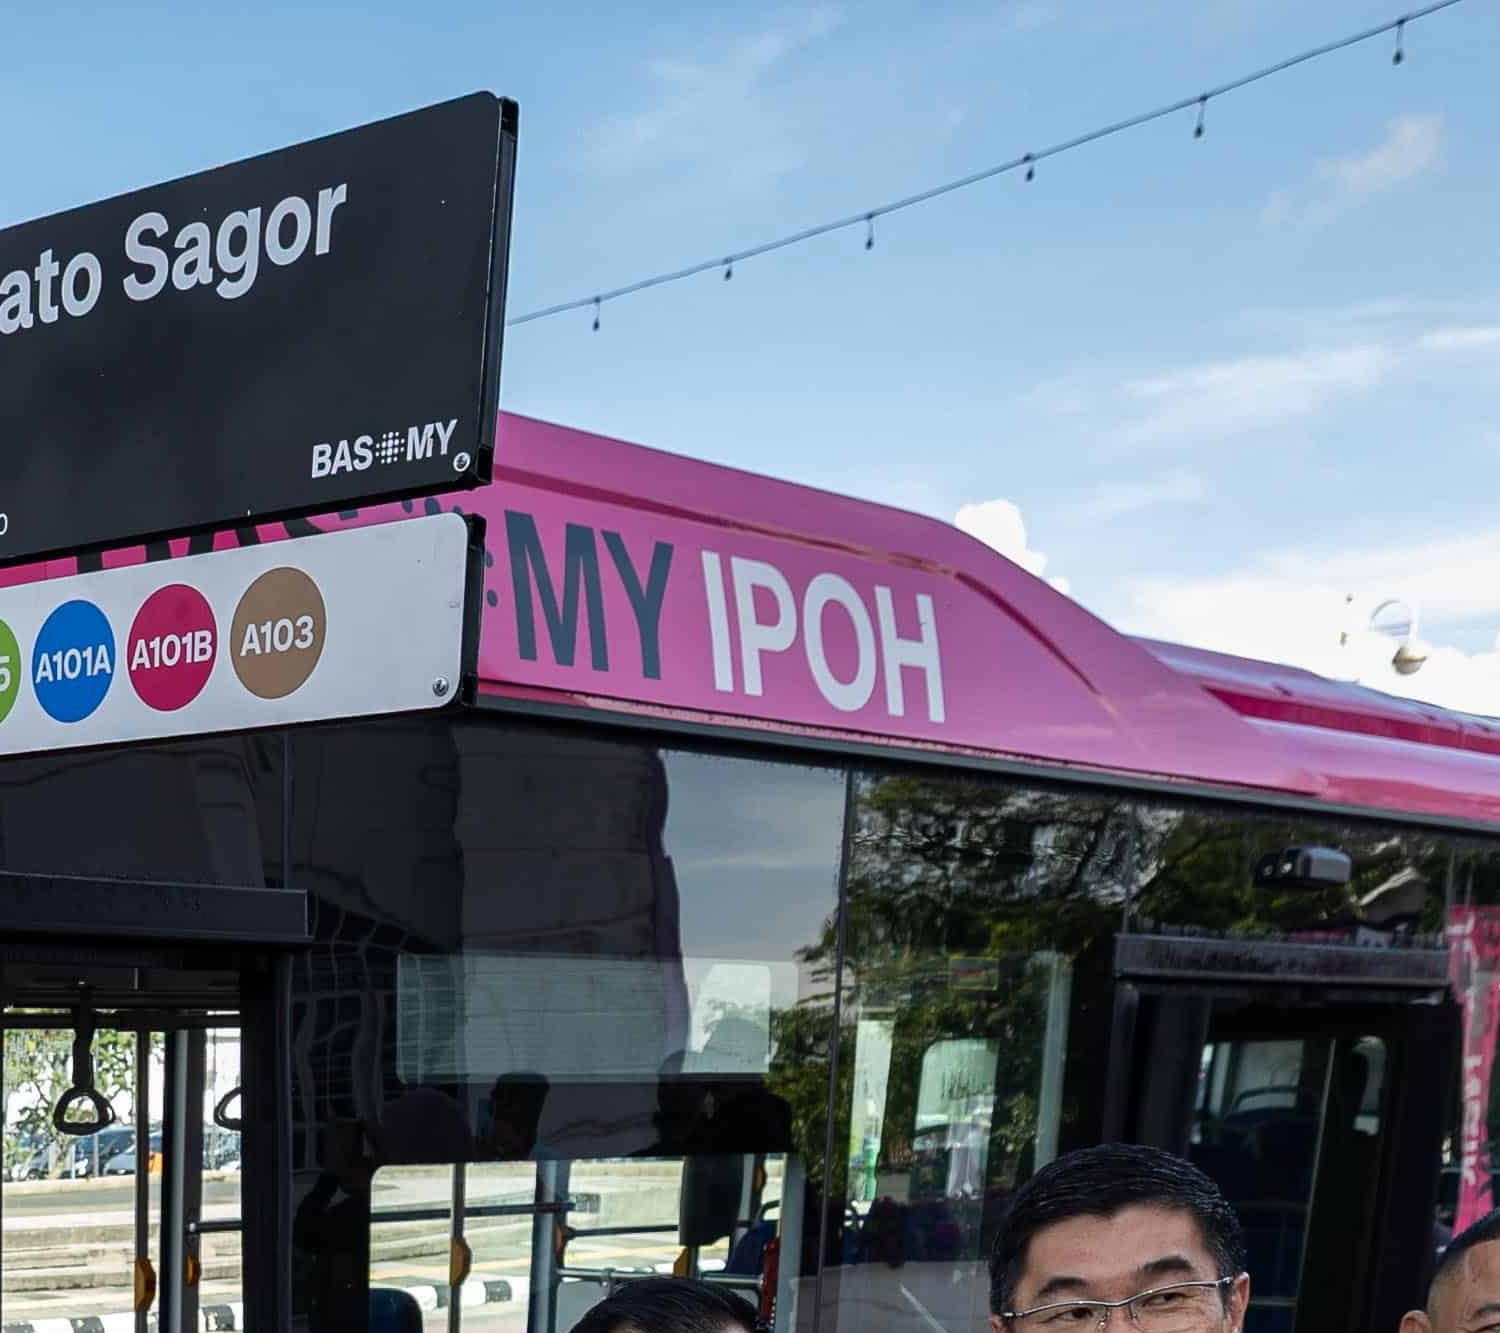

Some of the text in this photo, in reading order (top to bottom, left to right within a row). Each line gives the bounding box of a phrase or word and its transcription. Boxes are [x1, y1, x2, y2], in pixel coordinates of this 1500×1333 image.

[122, 183, 348, 301] Sagor
[34, 644, 112, 684] A101A
[130, 629, 213, 671] A101B
[240, 615, 314, 657] A103
[503, 509, 675, 681] MY
[701, 549, 946, 724] IPOH
